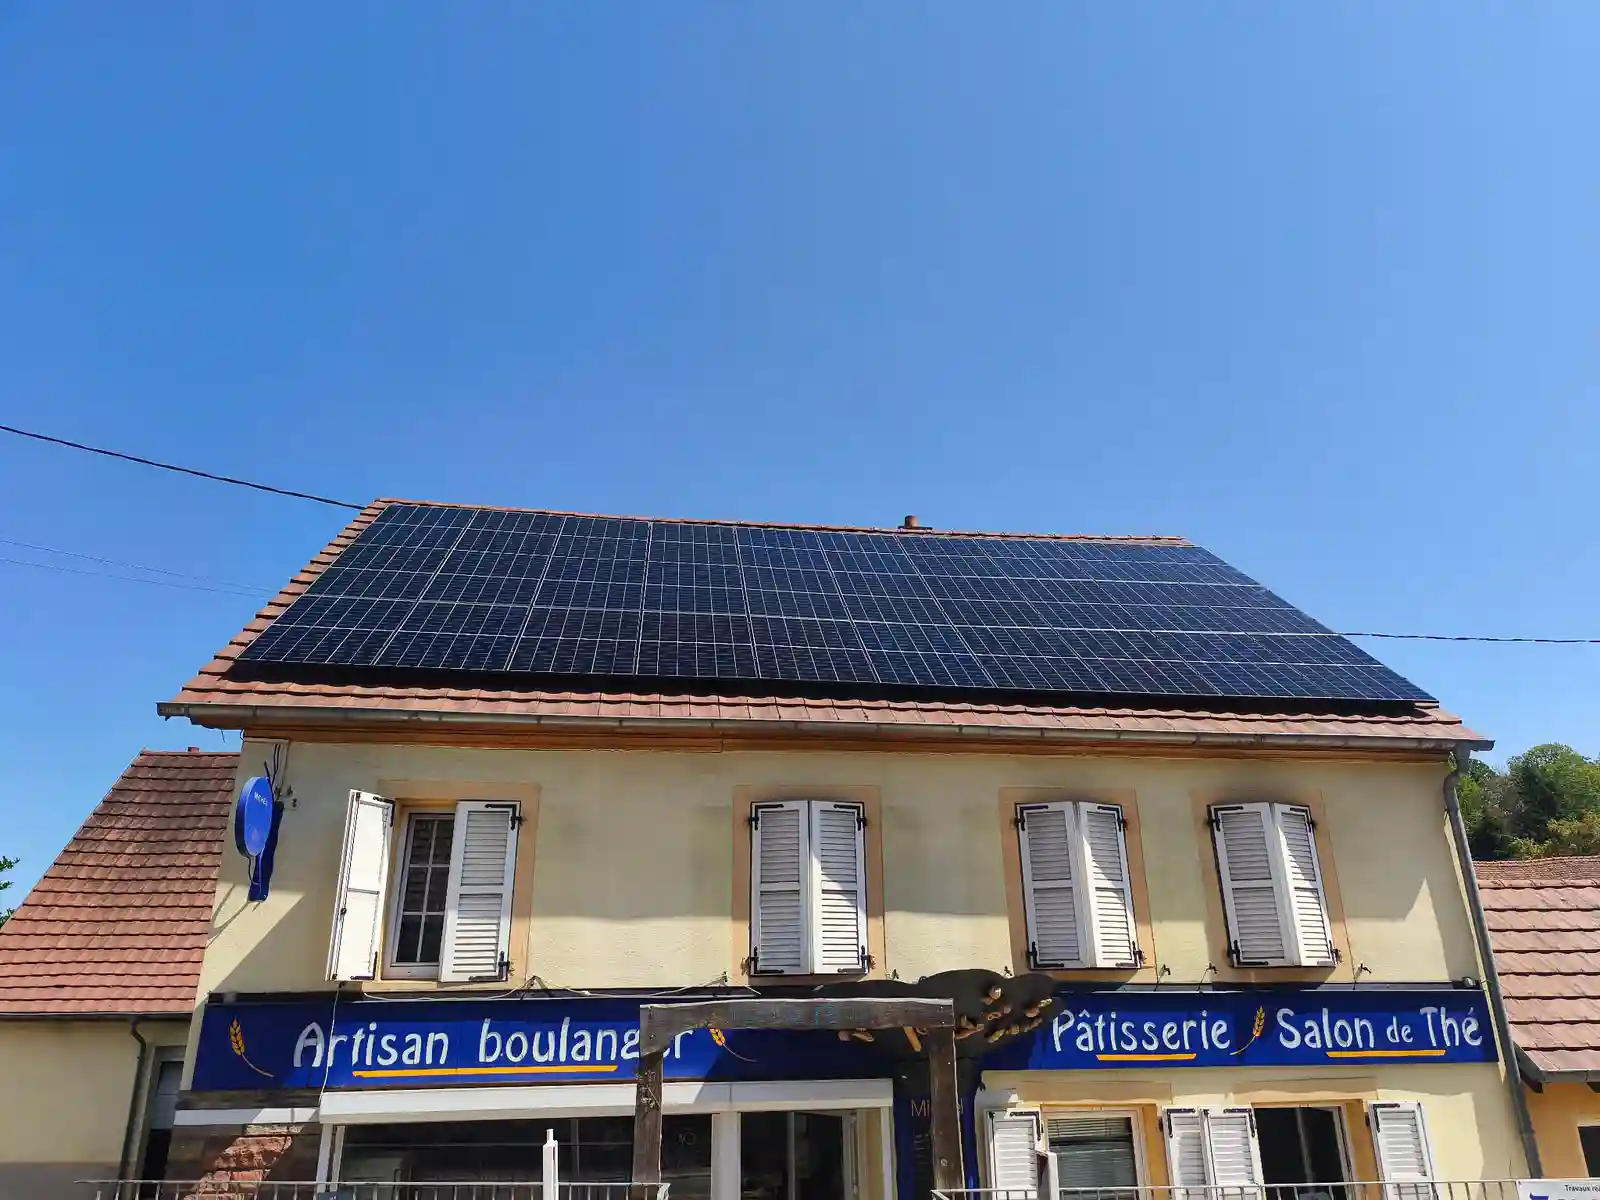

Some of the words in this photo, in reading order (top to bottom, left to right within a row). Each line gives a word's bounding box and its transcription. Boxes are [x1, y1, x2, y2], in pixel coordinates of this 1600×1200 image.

[293, 1021, 449, 1067] Artisan
[478, 1016, 694, 1063] boulangr
[1052, 1009, 1231, 1052] Pâtisserie
[1277, 1007, 1376, 1049] Salon
[1387, 1016, 1414, 1043] de
[1420, 1006, 1483, 1047] Thé
